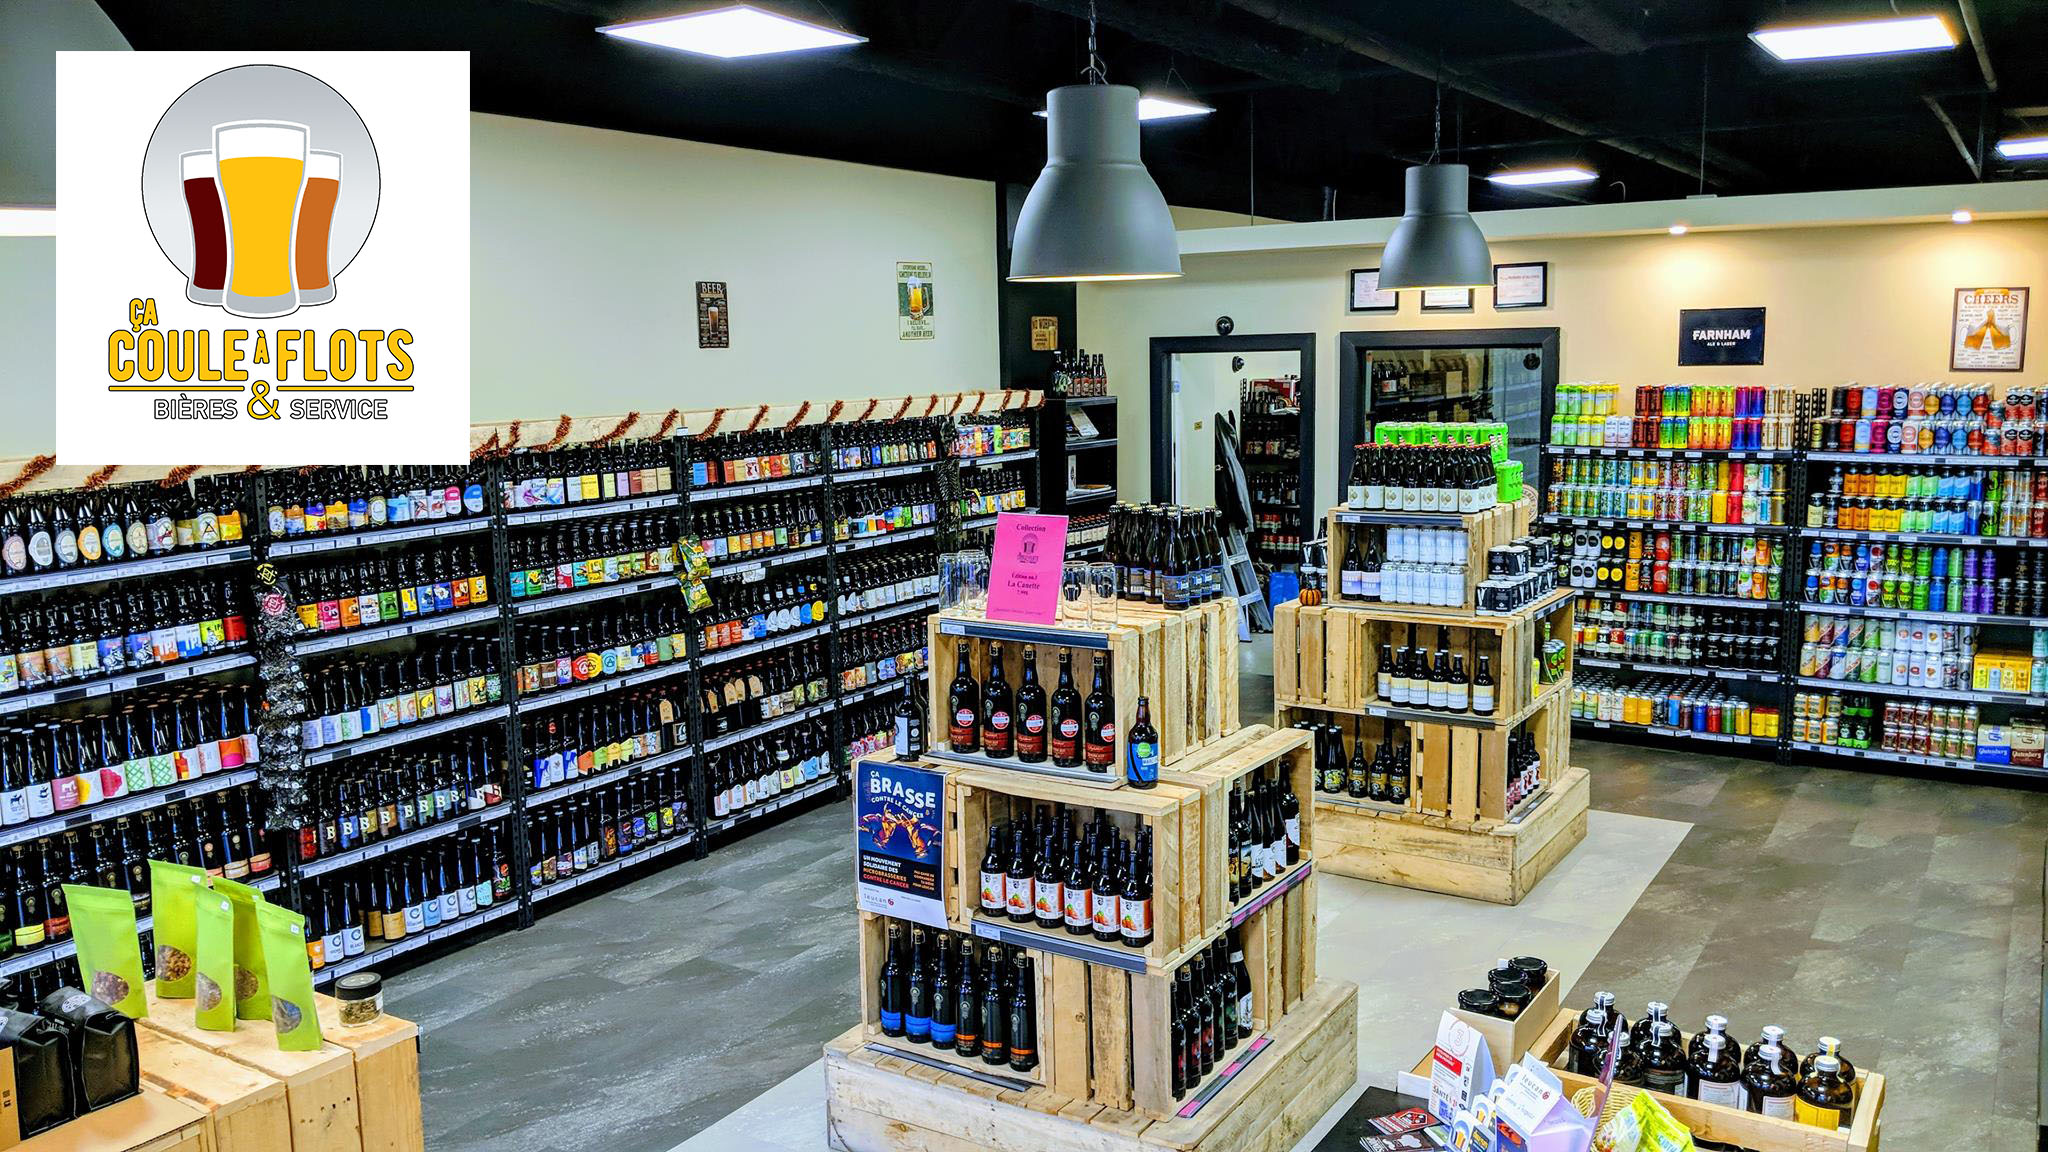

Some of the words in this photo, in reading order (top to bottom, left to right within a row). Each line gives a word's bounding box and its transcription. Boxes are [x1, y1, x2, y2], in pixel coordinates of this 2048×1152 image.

[701, 283, 722, 294] BEER
[1964, 294, 2019, 305] CHEERS
[1692, 329, 1751, 341] FARNHAM
[1016, 523, 1046, 532] Collection
[870, 770, 880, 778] ÇA
[870, 777, 936, 809] BRASSE
[871, 795, 894, 803] CONTRE
[894, 800, 902, 808] LE
[901, 805, 924, 819] CANCER
[863, 861, 888, 871] SOLIDAIRE
[888, 866, 898, 874] DES
[871, 856, 902, 868] MOUVEMENT
[863, 867, 907, 882] MICROBRASSERIES
[863, 874, 883, 883] CONTRE
[889, 879, 910, 889] CANCER
